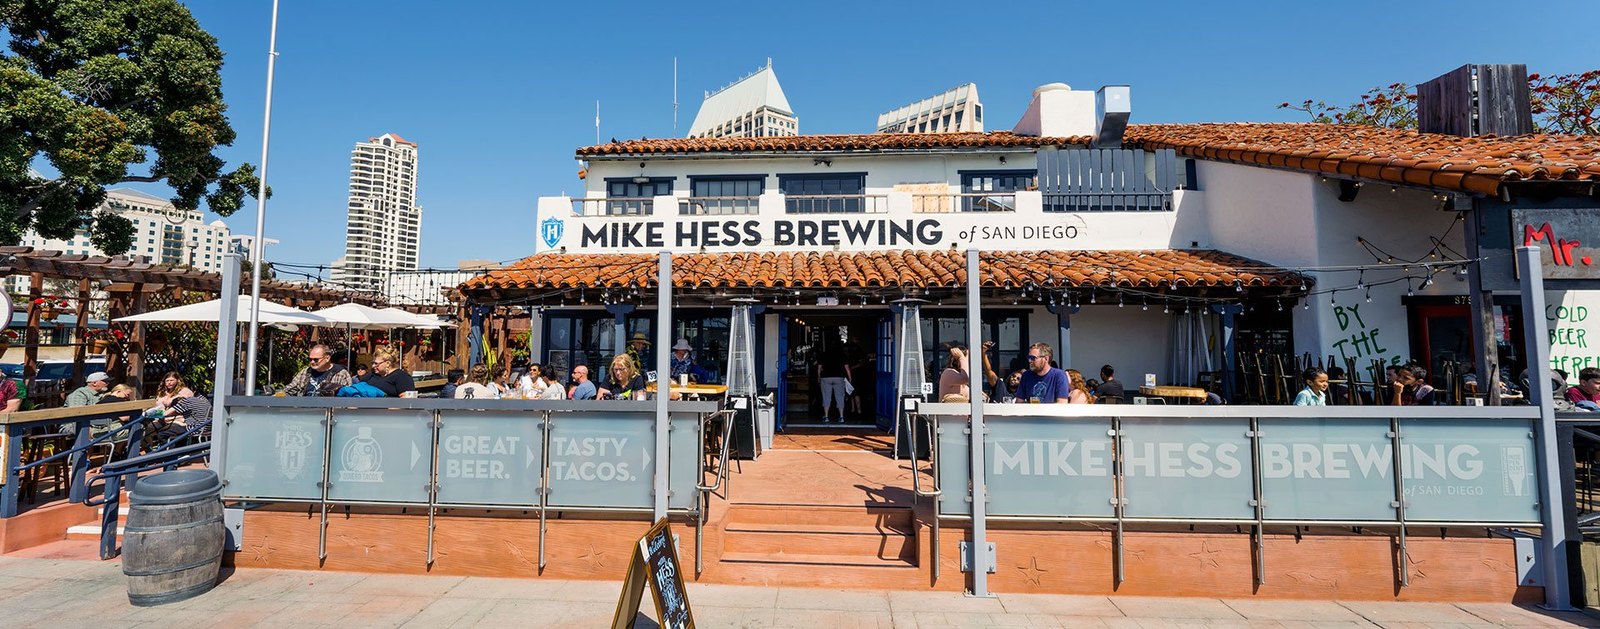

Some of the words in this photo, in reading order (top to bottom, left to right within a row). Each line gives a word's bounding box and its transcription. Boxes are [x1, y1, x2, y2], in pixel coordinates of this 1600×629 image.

[581, 222, 665, 248] MIKE
[675, 221, 762, 247] HESS
[774, 219, 943, 247] BREWING
[959, 226, 976, 243] of
[982, 226, 1016, 240] SAN
[1023, 225, 1078, 240] DIEGO
[1524, 221, 1593, 266] Mr.
[1333, 304, 1365, 331] BY
[1545, 305, 1588, 323] COLD
[1332, 328, 1387, 367] THE
[649, 372, 657, 380] 39
[444, 435, 520, 455] GREAT
[553, 437, 628, 457] TASTY
[446, 459, 511, 480] BEER.
[993, 440, 1107, 476] MIKE
[1123, 441, 1242, 478] HESS
[1262, 443, 1484, 480] BREWING
[552, 461, 636, 482] TACOS.
[1418, 486, 1441, 496] SAN
[1448, 486, 1484, 496] DIEGO
